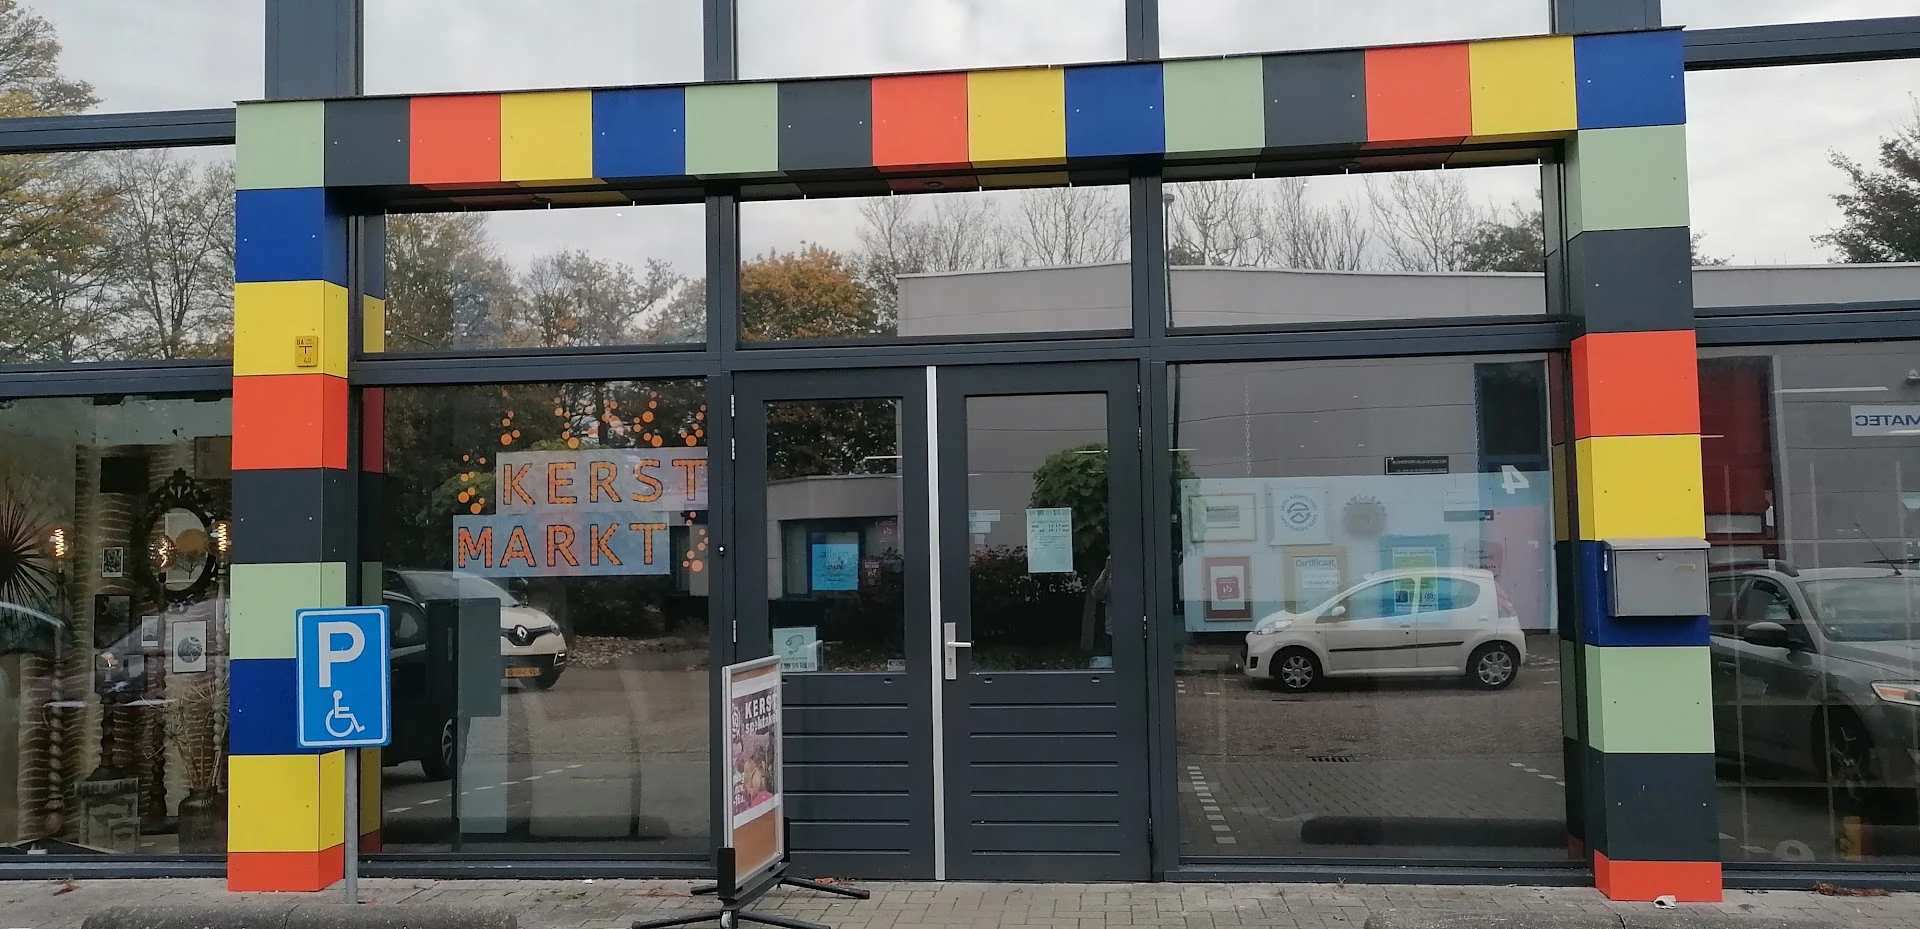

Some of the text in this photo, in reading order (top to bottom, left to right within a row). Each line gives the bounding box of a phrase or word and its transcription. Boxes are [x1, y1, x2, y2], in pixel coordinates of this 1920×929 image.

[503, 459, 708, 506] KERST
[457, 523, 668, 568] MARKT
[318, 621, 366, 688] P
[744, 692, 777, 720] KERST
